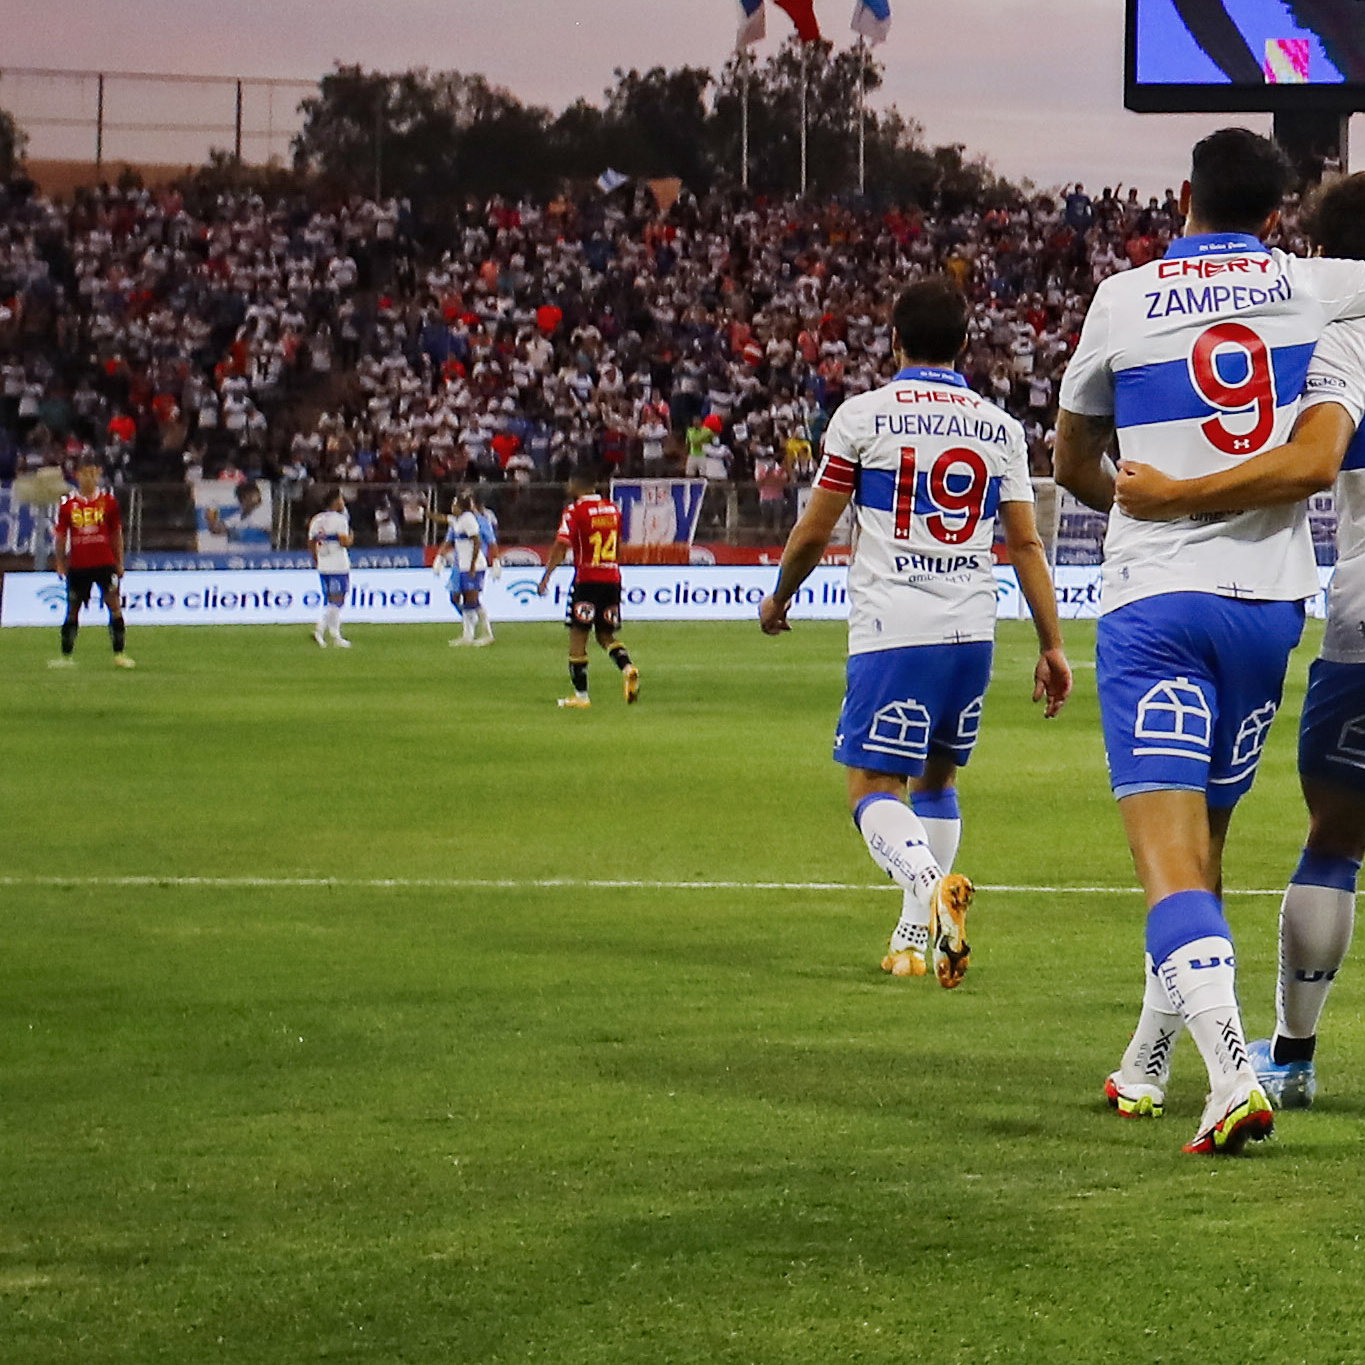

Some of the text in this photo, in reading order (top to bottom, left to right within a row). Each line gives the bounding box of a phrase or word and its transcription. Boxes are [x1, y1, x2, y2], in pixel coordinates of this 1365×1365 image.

[1158, 257, 1271, 279] CHERY
[1144, 275, 1293, 319] ZAMPEDRI
[895, 389, 981, 409] CHERY
[1187, 320, 1279, 457] 9
[875, 414, 1008, 446] FUENZALIDA
[893, 446, 990, 545] 19
[588, 530, 617, 567] 14
[357, 556, 410, 568] ATAM
[894, 554, 980, 574] PHILIPS
[183, 586, 293, 609] cliente
[352, 584, 431, 607] línea
[654, 581, 764, 604] cliente
